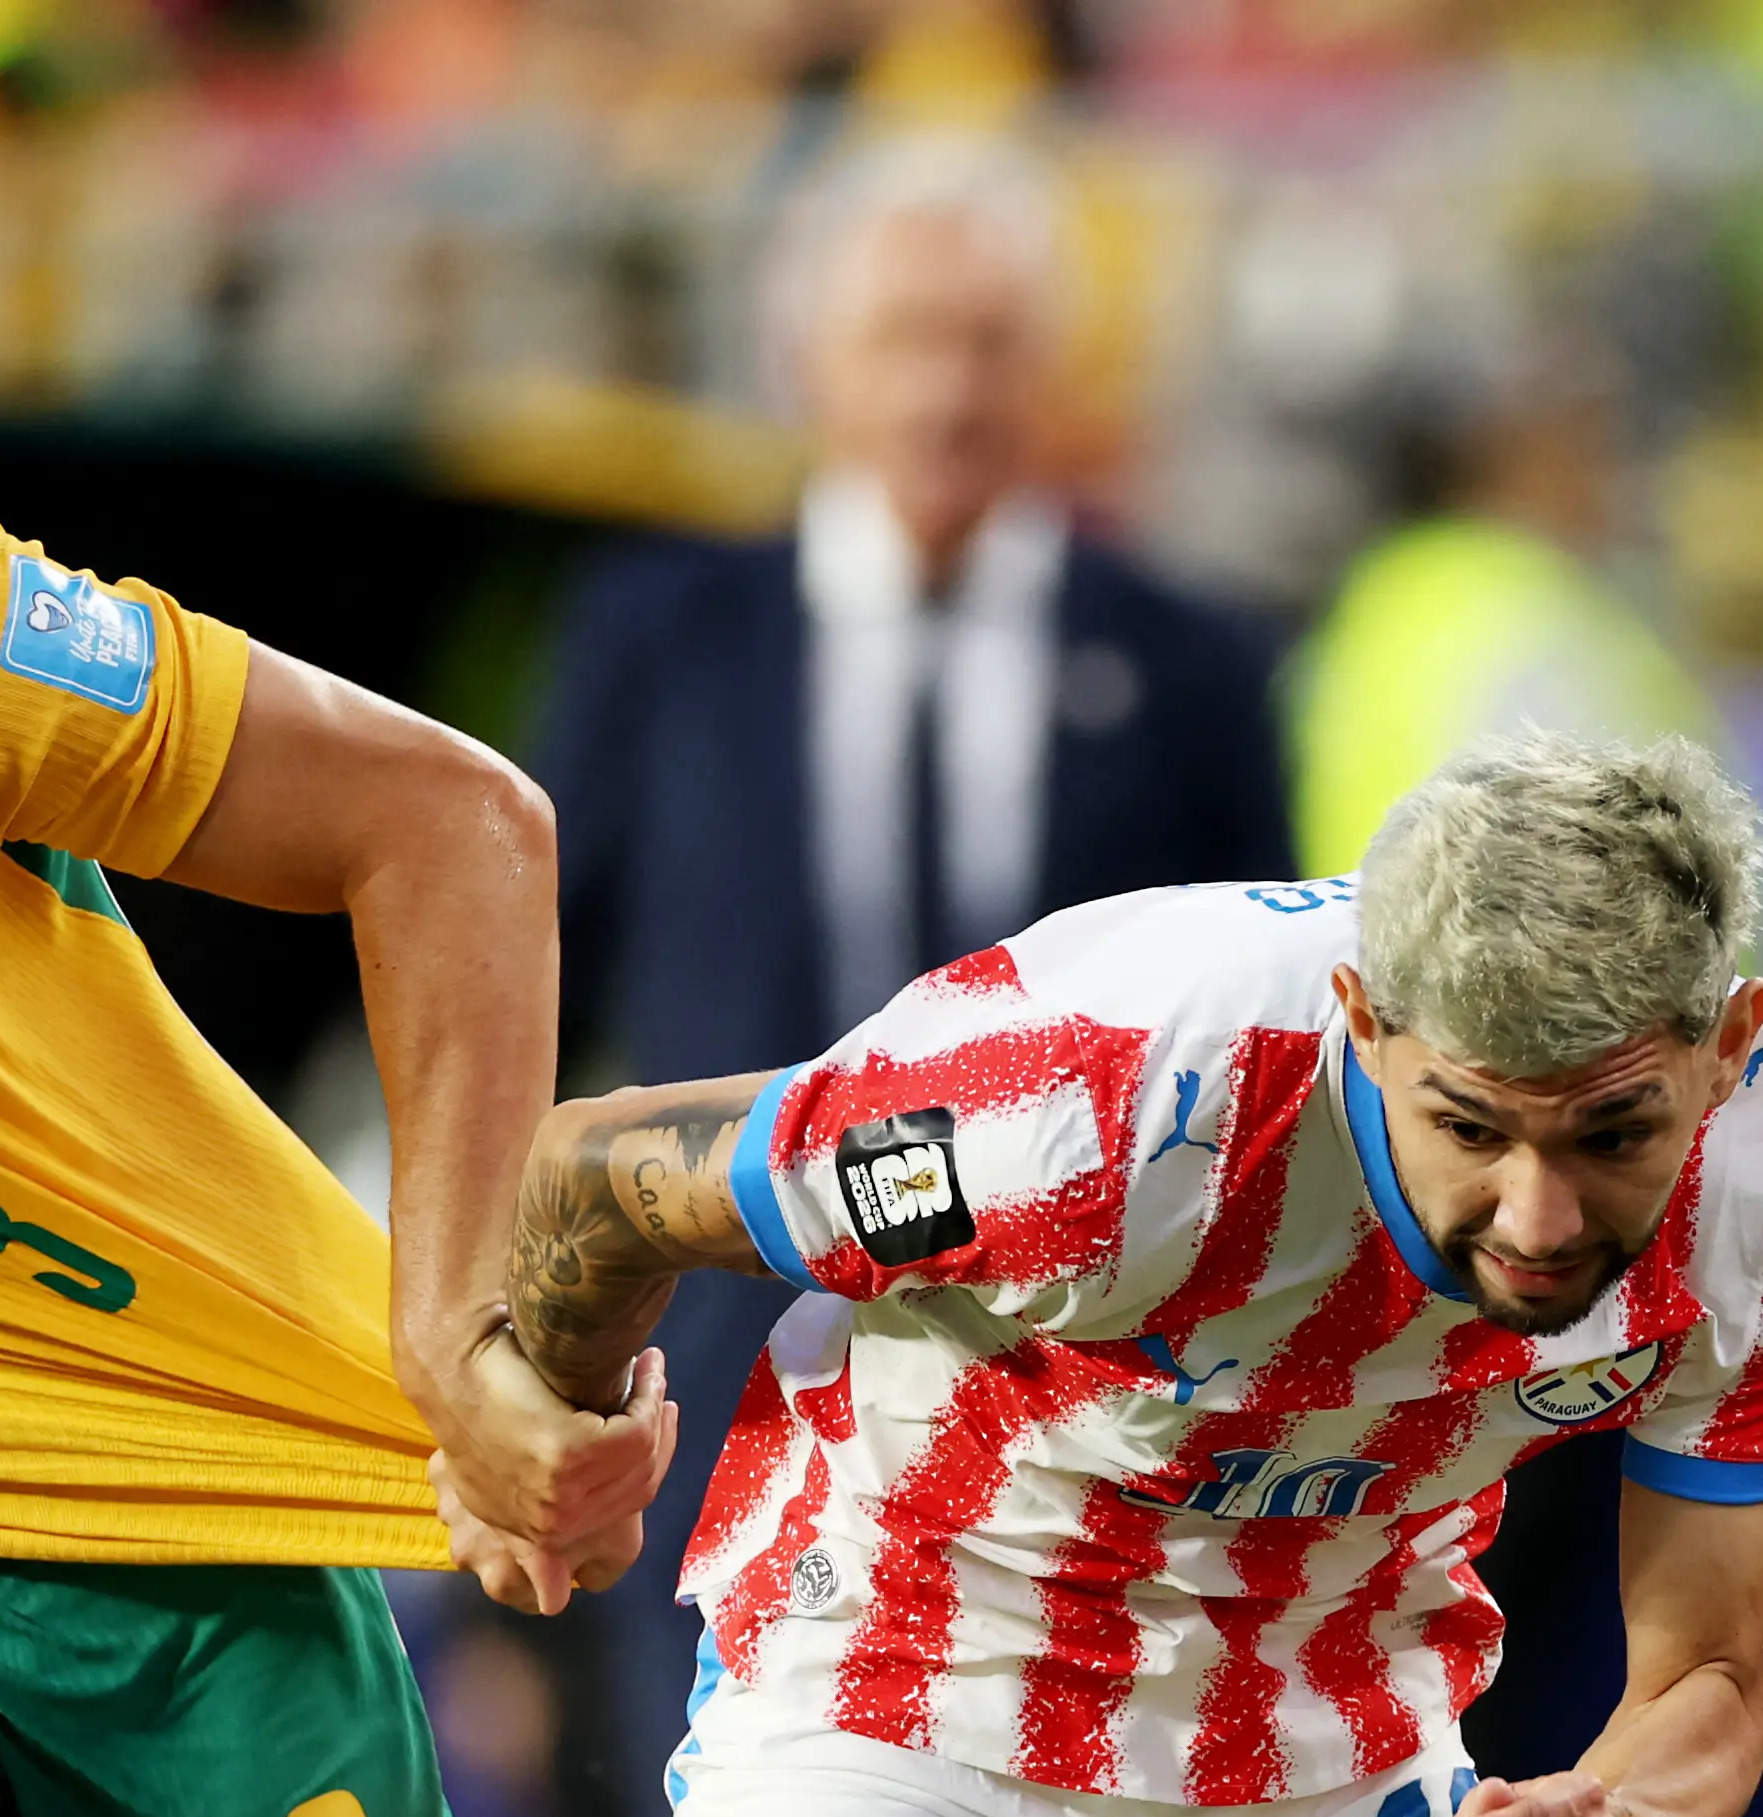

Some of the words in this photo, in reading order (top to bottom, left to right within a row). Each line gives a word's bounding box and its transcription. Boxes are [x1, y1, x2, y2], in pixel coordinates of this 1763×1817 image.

[96, 611, 122, 667] PEAC
[846, 1165, 877, 1234] 2026
[858, 1163, 877, 1206] WORLD
[872, 1206, 885, 1231] CUP
[881, 1177, 896, 1207] FIFA
[1534, 1397, 1597, 1415] PARAGUAY
